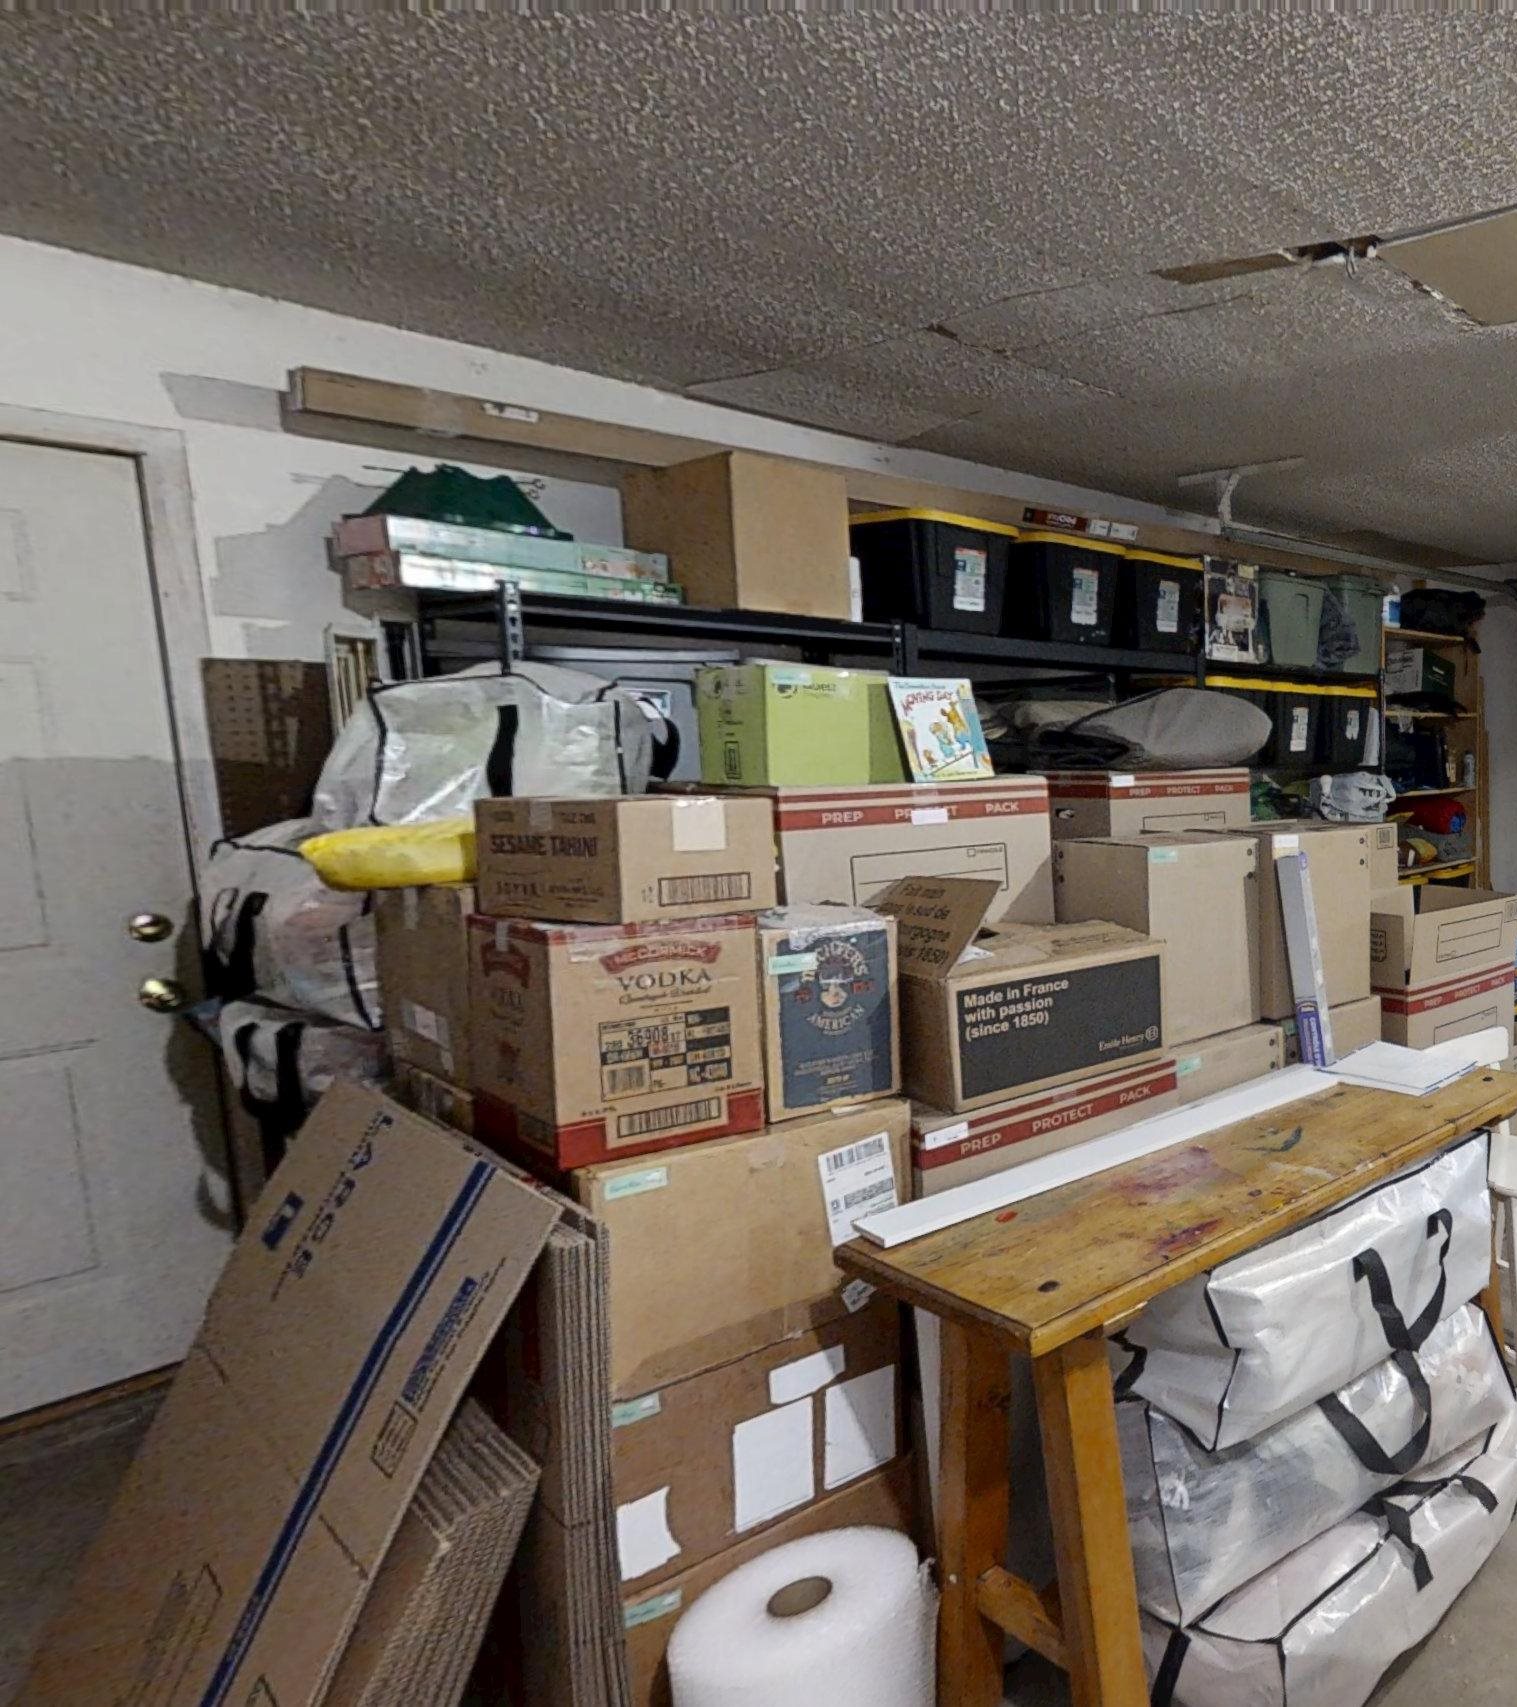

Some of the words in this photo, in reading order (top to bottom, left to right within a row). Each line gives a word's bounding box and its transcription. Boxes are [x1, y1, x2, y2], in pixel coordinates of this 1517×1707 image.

[821, 810, 864, 824] PREP
[985, 801, 1020, 814] PACK
[617, 968, 711, 991] VODKA
[963, 993, 1003, 1008] Made
[1006, 986, 1021, 1000] in
[1023, 979, 1069, 999] France
[964, 1007, 996, 1023] with
[999, 996, 1054, 1020] passion
[965, 1021, 1010, 1042] (since
[1013, 1011, 1050, 1029] 1850)
[960, 1132, 1002, 1155] PREP
[1031, 1102, 1094, 1133] PROTECT
[1119, 1084, 1152, 1105] PACK
